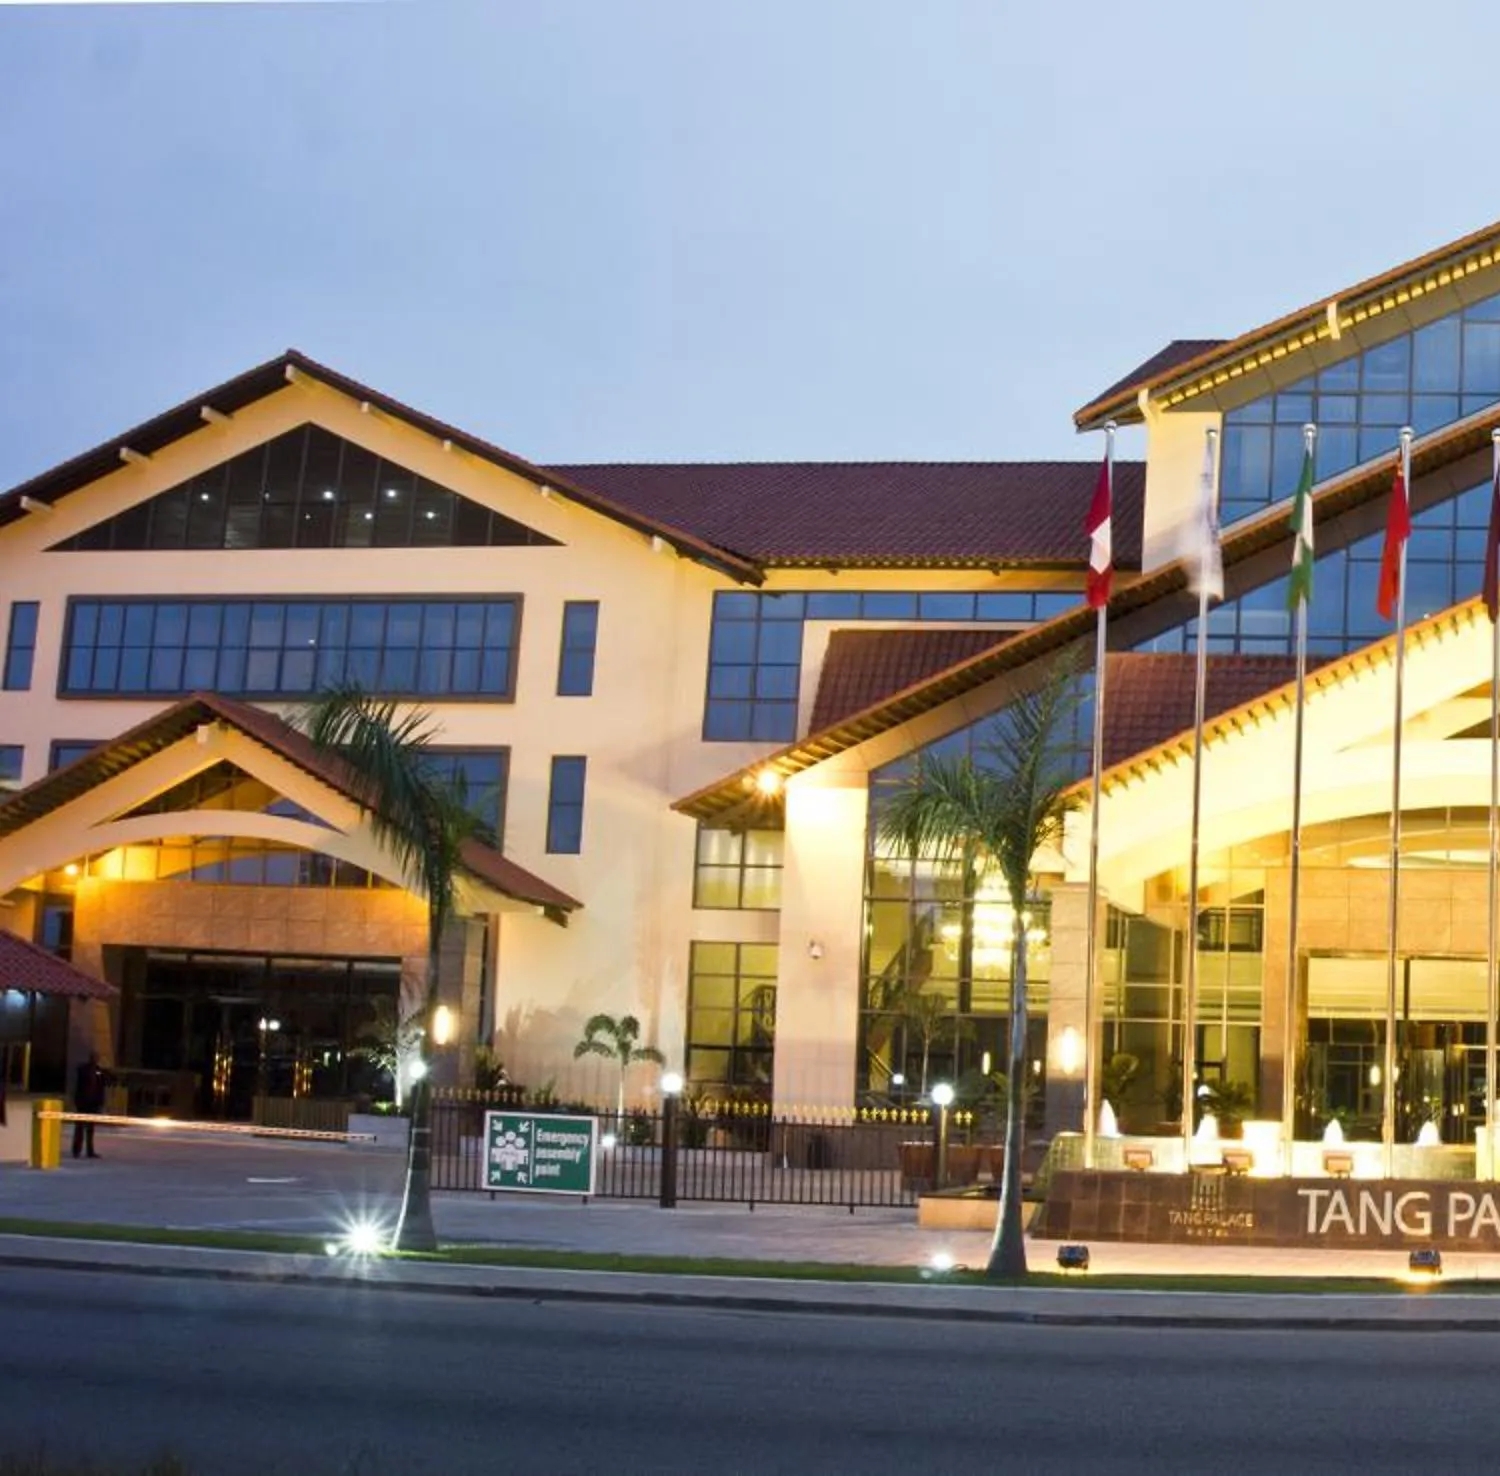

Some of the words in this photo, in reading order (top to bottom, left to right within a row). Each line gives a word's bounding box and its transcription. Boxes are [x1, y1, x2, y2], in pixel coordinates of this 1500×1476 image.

[537, 1128, 589, 1147] Emergency
[535, 1163, 560, 1177] point
[1168, 1210, 1202, 1225] TANG
[1203, 1212, 1253, 1227] PALACE
[1297, 1189, 1432, 1236] TANG
